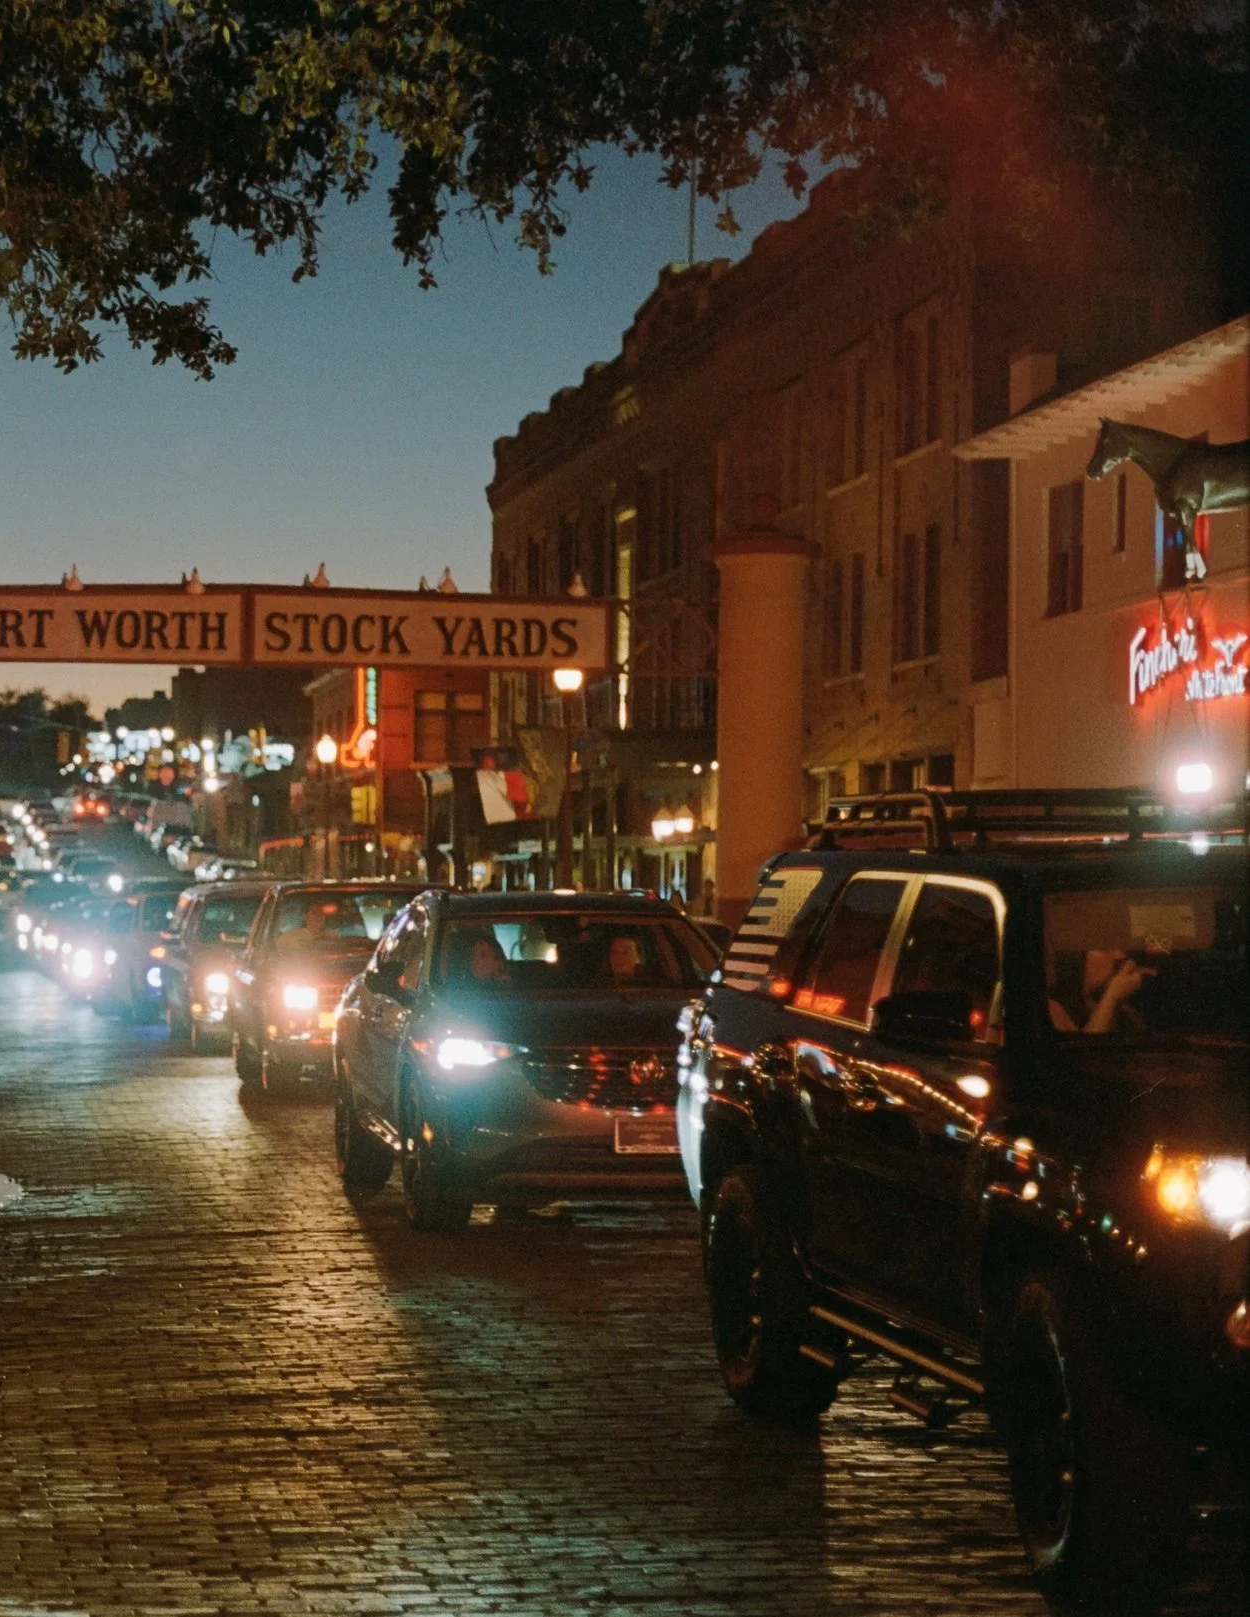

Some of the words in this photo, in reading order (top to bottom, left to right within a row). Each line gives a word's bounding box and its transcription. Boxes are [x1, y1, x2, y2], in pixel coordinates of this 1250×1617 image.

[74, 609, 228, 651] WORTH
[264, 612, 411, 655] STOCK
[432, 615, 579, 658] YARDS
